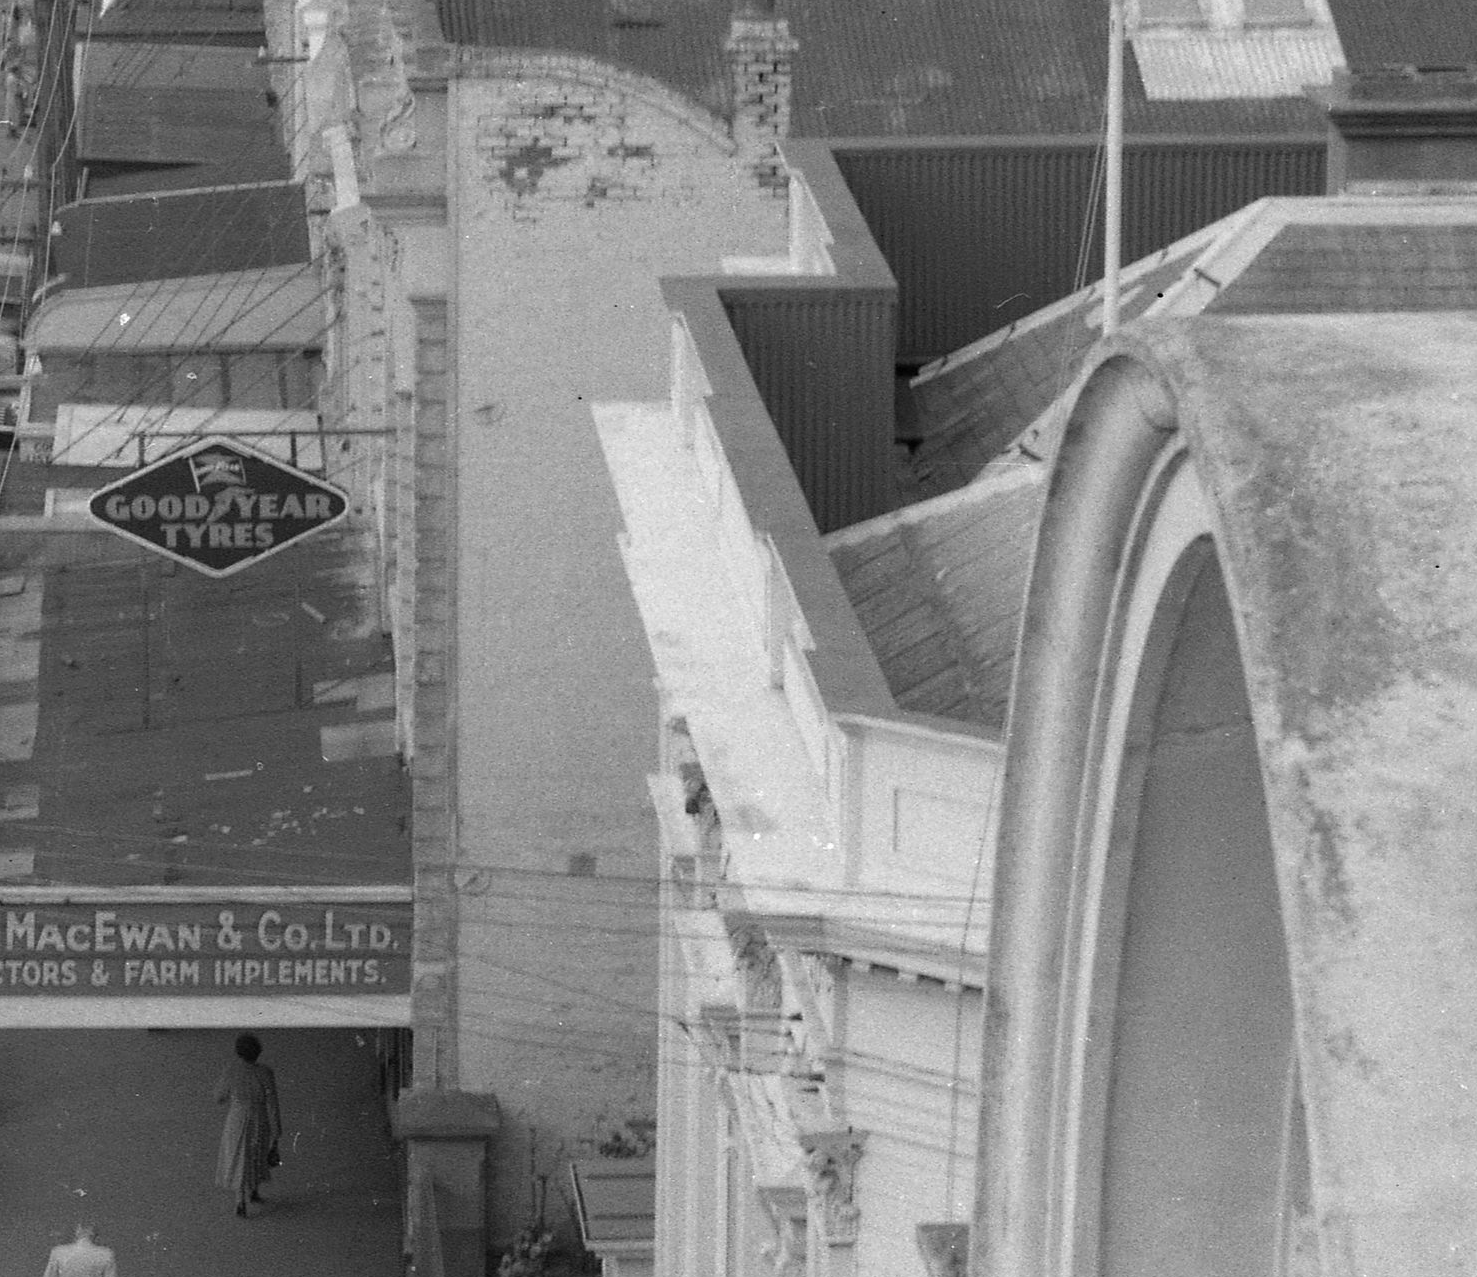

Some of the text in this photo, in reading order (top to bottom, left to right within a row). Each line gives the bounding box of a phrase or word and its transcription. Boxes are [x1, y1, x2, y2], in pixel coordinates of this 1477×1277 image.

[159, 523, 274, 549] TYRES
[218, 910, 245, 952] &
[90, 960, 109, 986] &
[124, 960, 201, 987] FARM
